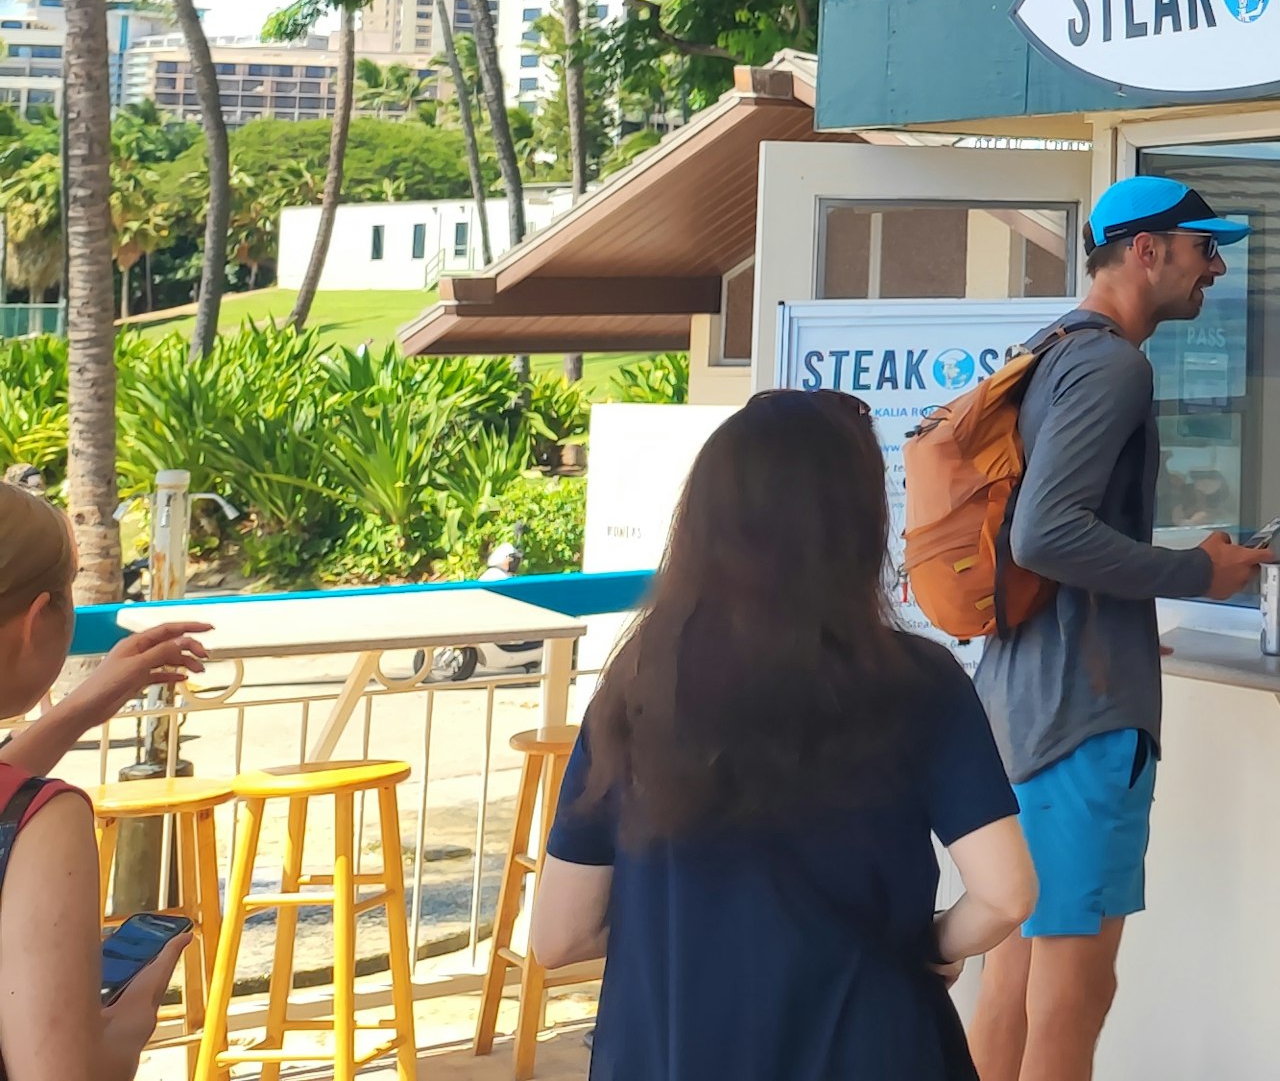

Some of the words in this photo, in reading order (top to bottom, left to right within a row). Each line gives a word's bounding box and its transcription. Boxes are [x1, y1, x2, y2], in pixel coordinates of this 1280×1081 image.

[1186, 326, 1226, 348] PASS
[802, 349, 927, 392] STEAK
[875, 407, 908, 417] KALIA
